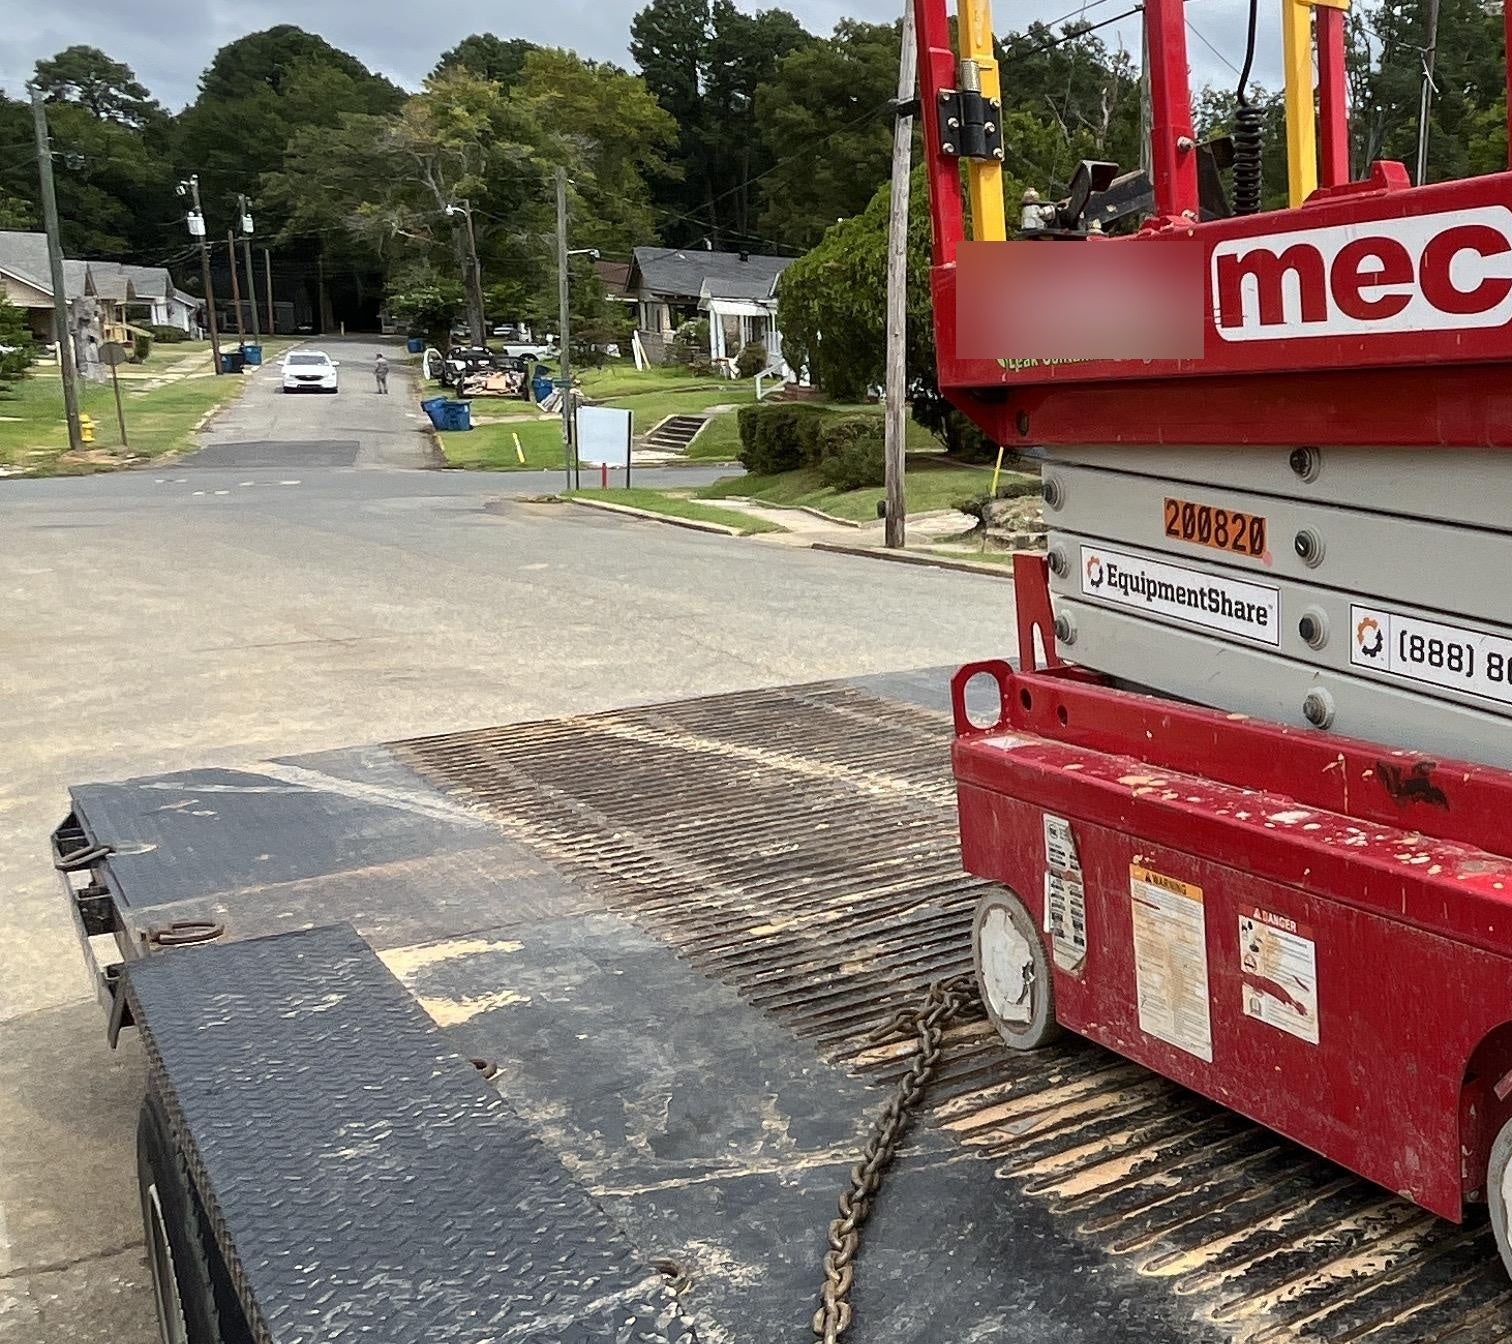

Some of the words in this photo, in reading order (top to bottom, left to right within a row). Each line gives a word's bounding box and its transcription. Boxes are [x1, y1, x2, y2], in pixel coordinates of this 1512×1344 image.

[1165, 499, 1267, 556] 200820
[1106, 562, 1269, 627] EquipmentShare
[1399, 629, 1475, 678] (888)
[1263, 910, 1298, 933] DANGER
